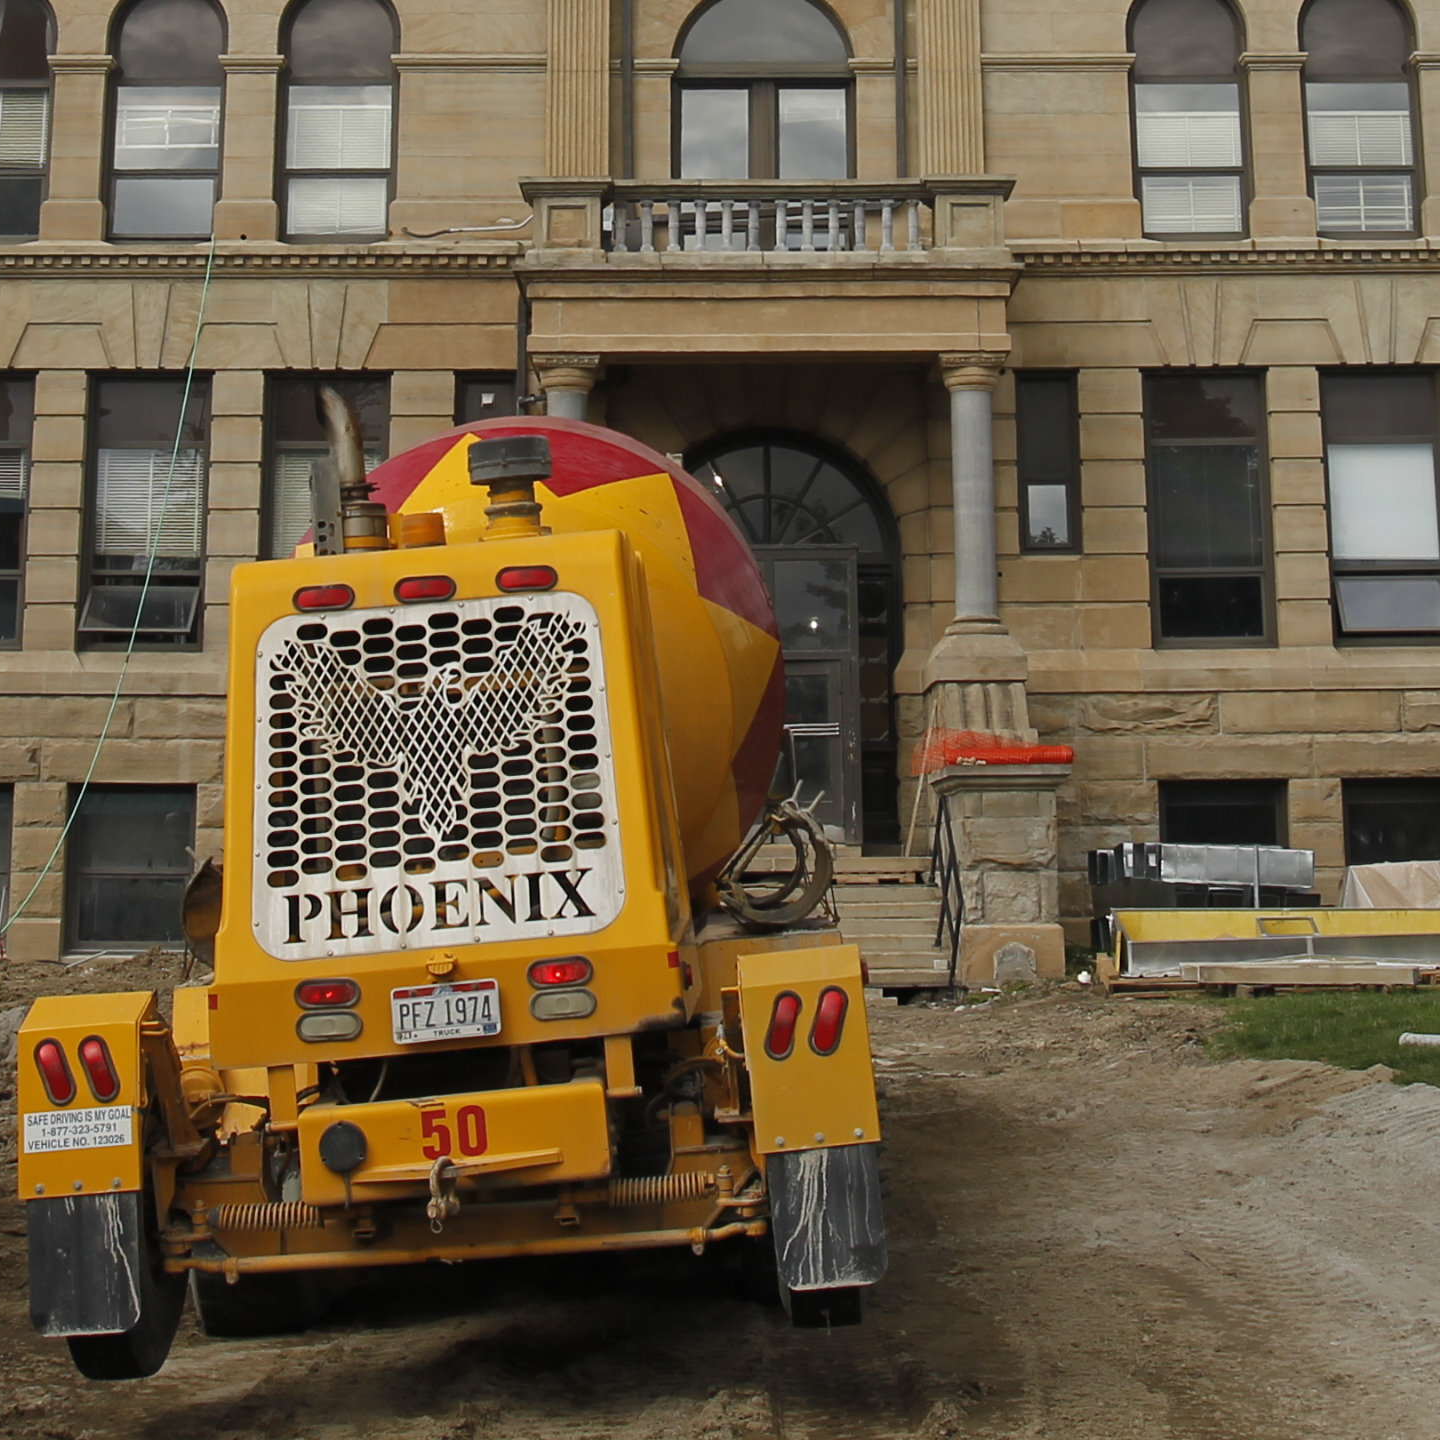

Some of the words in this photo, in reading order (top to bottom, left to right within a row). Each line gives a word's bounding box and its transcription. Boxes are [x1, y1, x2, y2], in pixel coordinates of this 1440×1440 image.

[282, 867, 597, 945] PHOENIX
[399, 1001, 436, 1030] PFZ
[444, 995, 492, 1025] 1974
[433, 1028, 461, 1037] TRUCK
[27, 1114, 49, 1127] SAFE
[50, 1111, 83, 1125] DRIVING
[85, 1110, 93, 1122] IS
[94, 1109, 109, 1121] MY
[108, 1107, 131, 1120] GOAL
[41, 1122, 117, 1137] 1-877-323-5791
[420, 1104, 488, 1161] 50
[27, 1138, 70, 1151] VEHICLE
[72, 1137, 90, 1147] NO.
[93, 1134, 125, 1146] 123026
